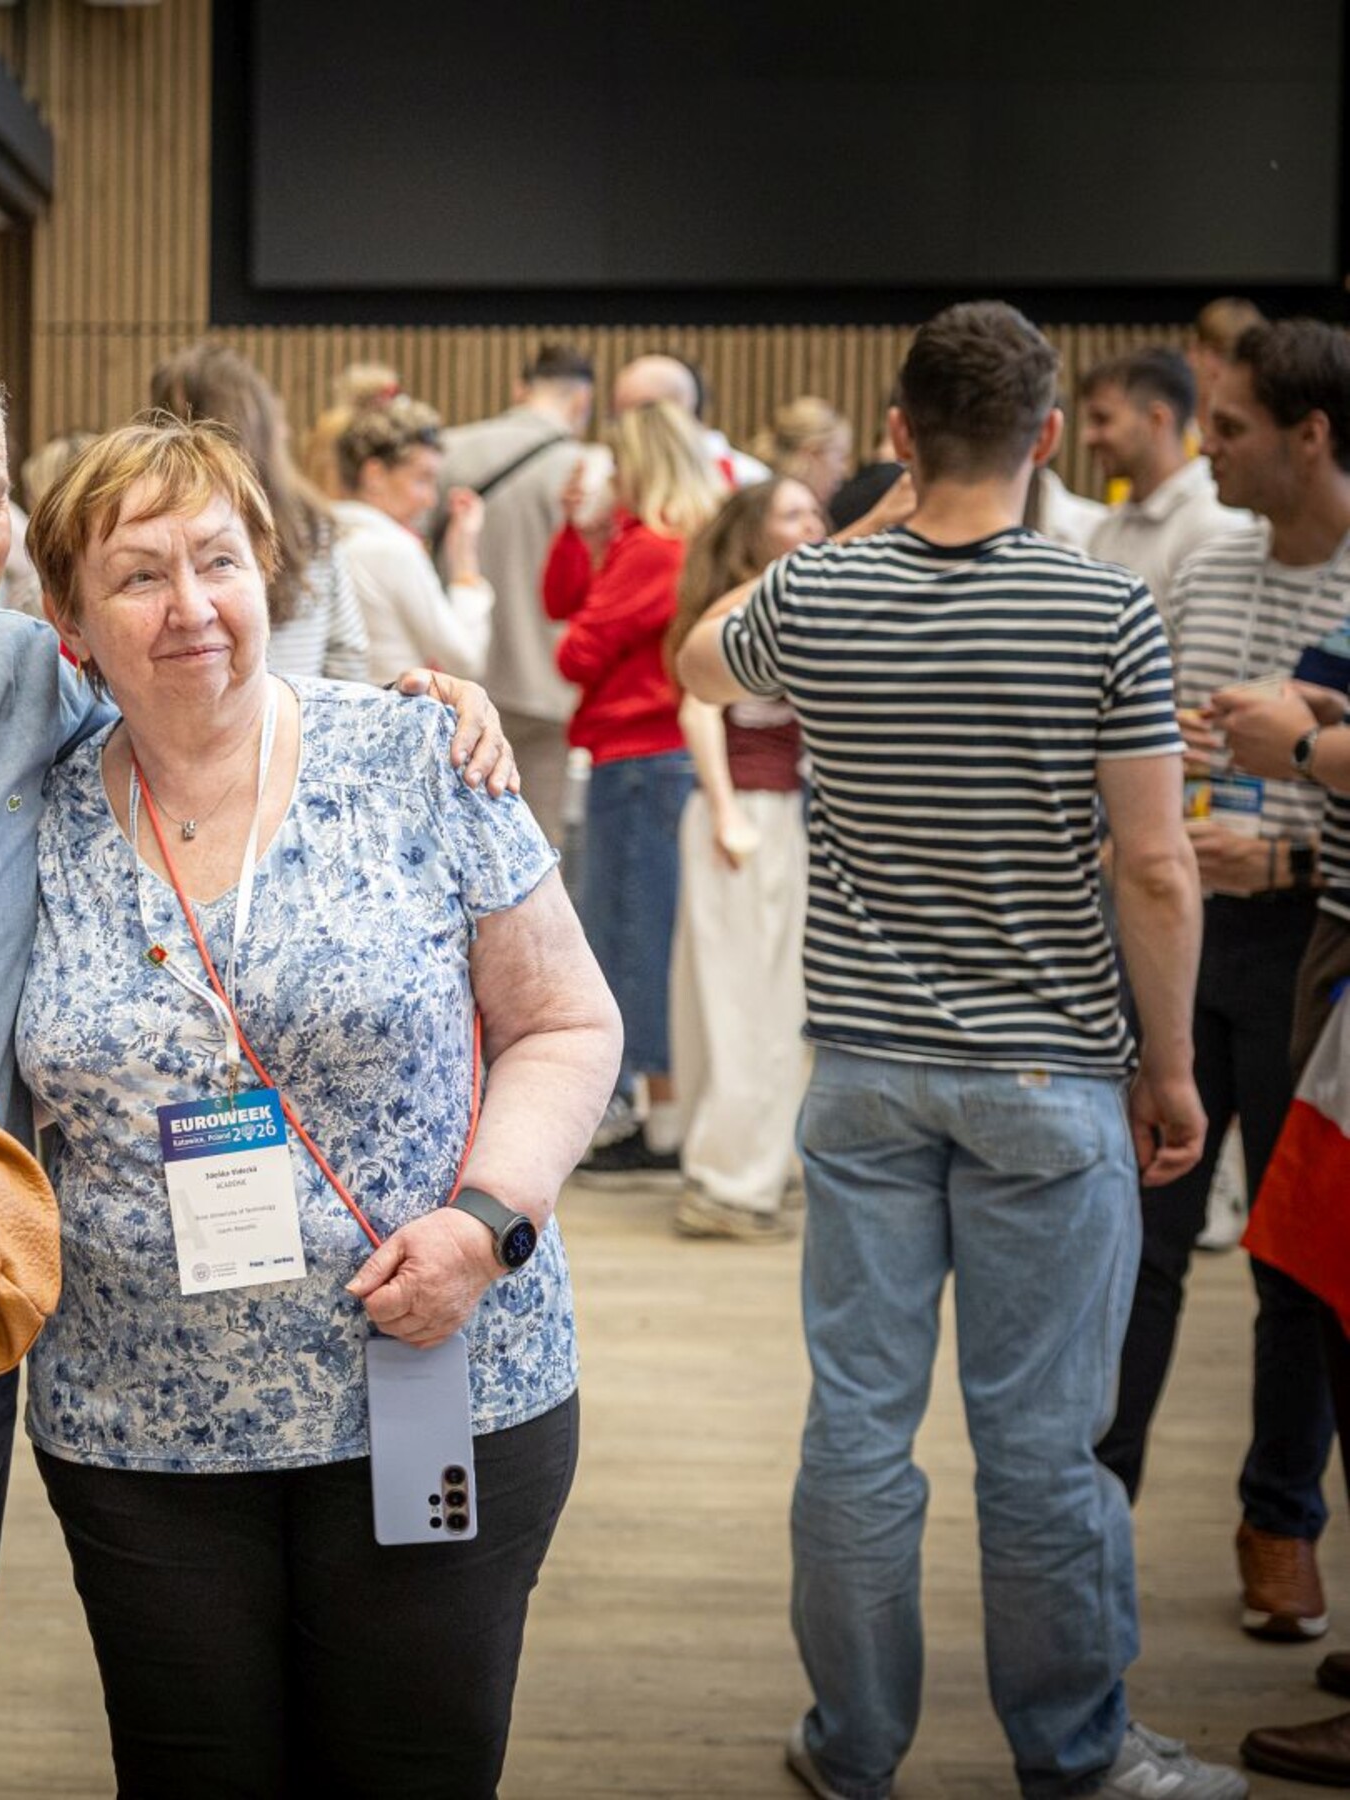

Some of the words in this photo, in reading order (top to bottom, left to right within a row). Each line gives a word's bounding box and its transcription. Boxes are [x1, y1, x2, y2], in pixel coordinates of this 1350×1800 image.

[171, 1105, 272, 1133] EUROWEEK
[173, 1136, 205, 1147] Katowice,
[208, 1131, 231, 1142] Poland
